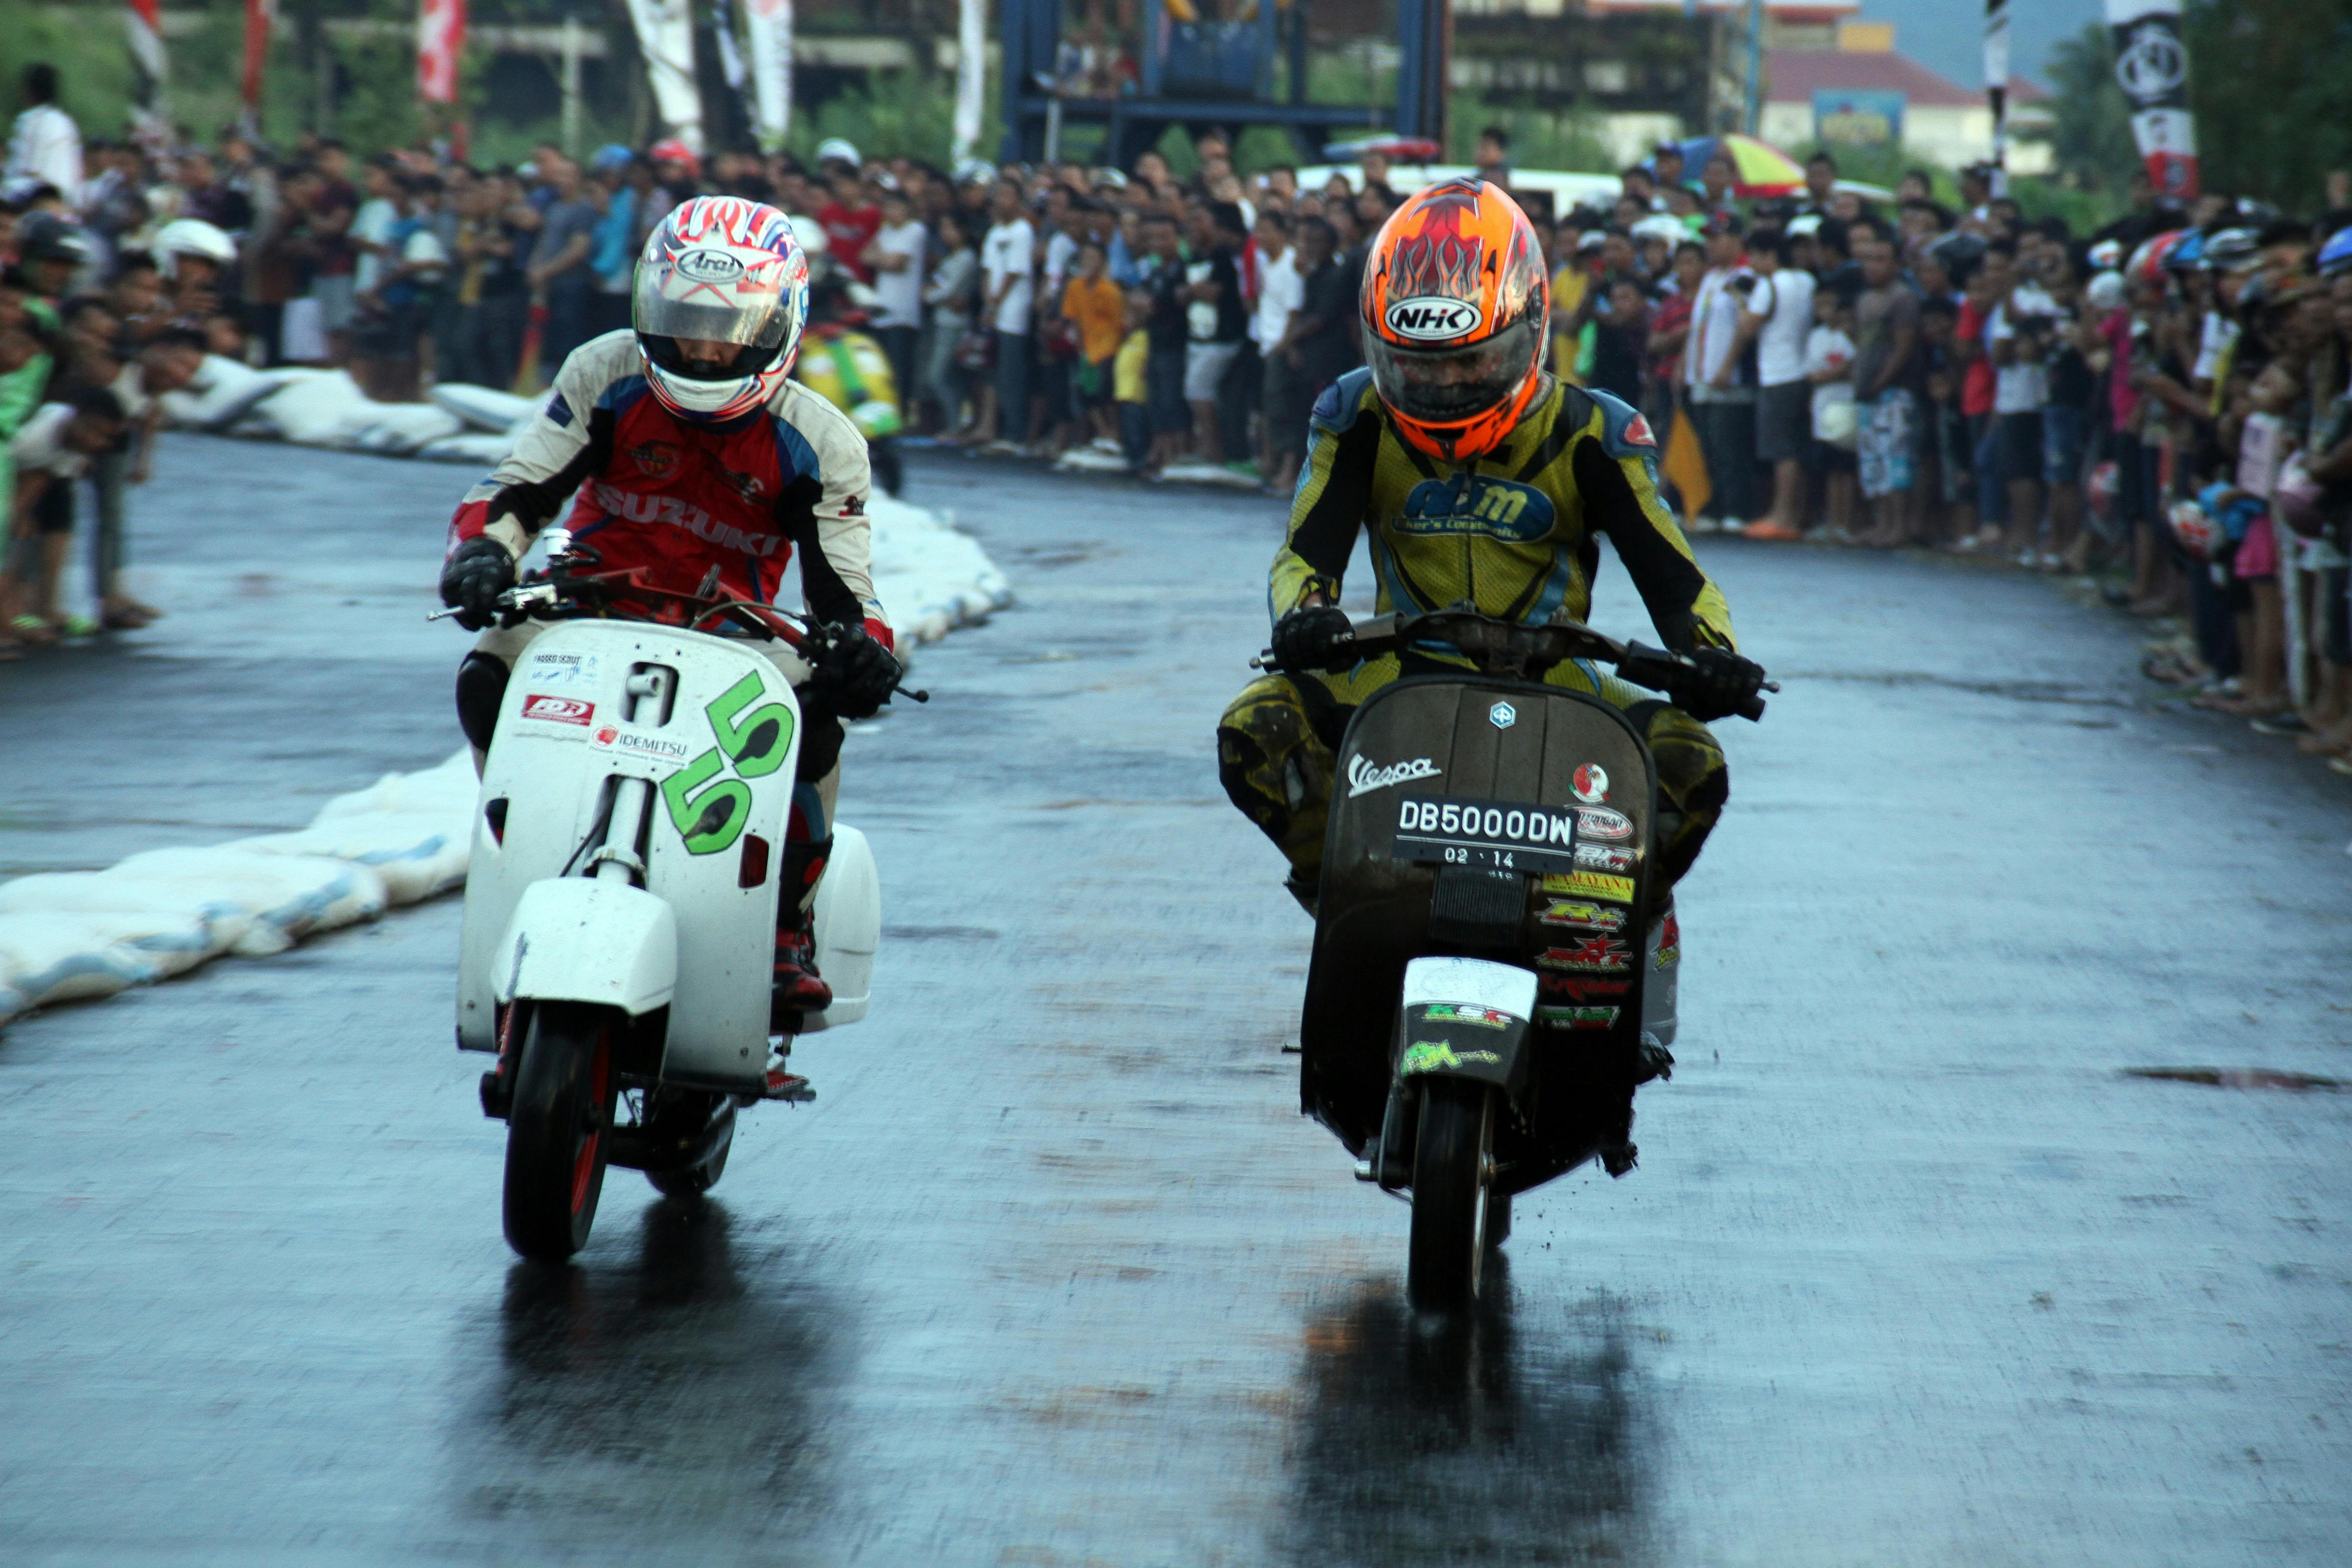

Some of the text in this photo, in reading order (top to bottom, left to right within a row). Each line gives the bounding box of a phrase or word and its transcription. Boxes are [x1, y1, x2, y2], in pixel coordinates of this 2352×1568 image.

[682, 253, 736, 273] Arai
[1396, 308, 1467, 328] NHK
[594, 483, 781, 556] SUZUKI
[619, 733, 687, 756] IDEMITSU
[1348, 753, 1442, 798] Vespa
